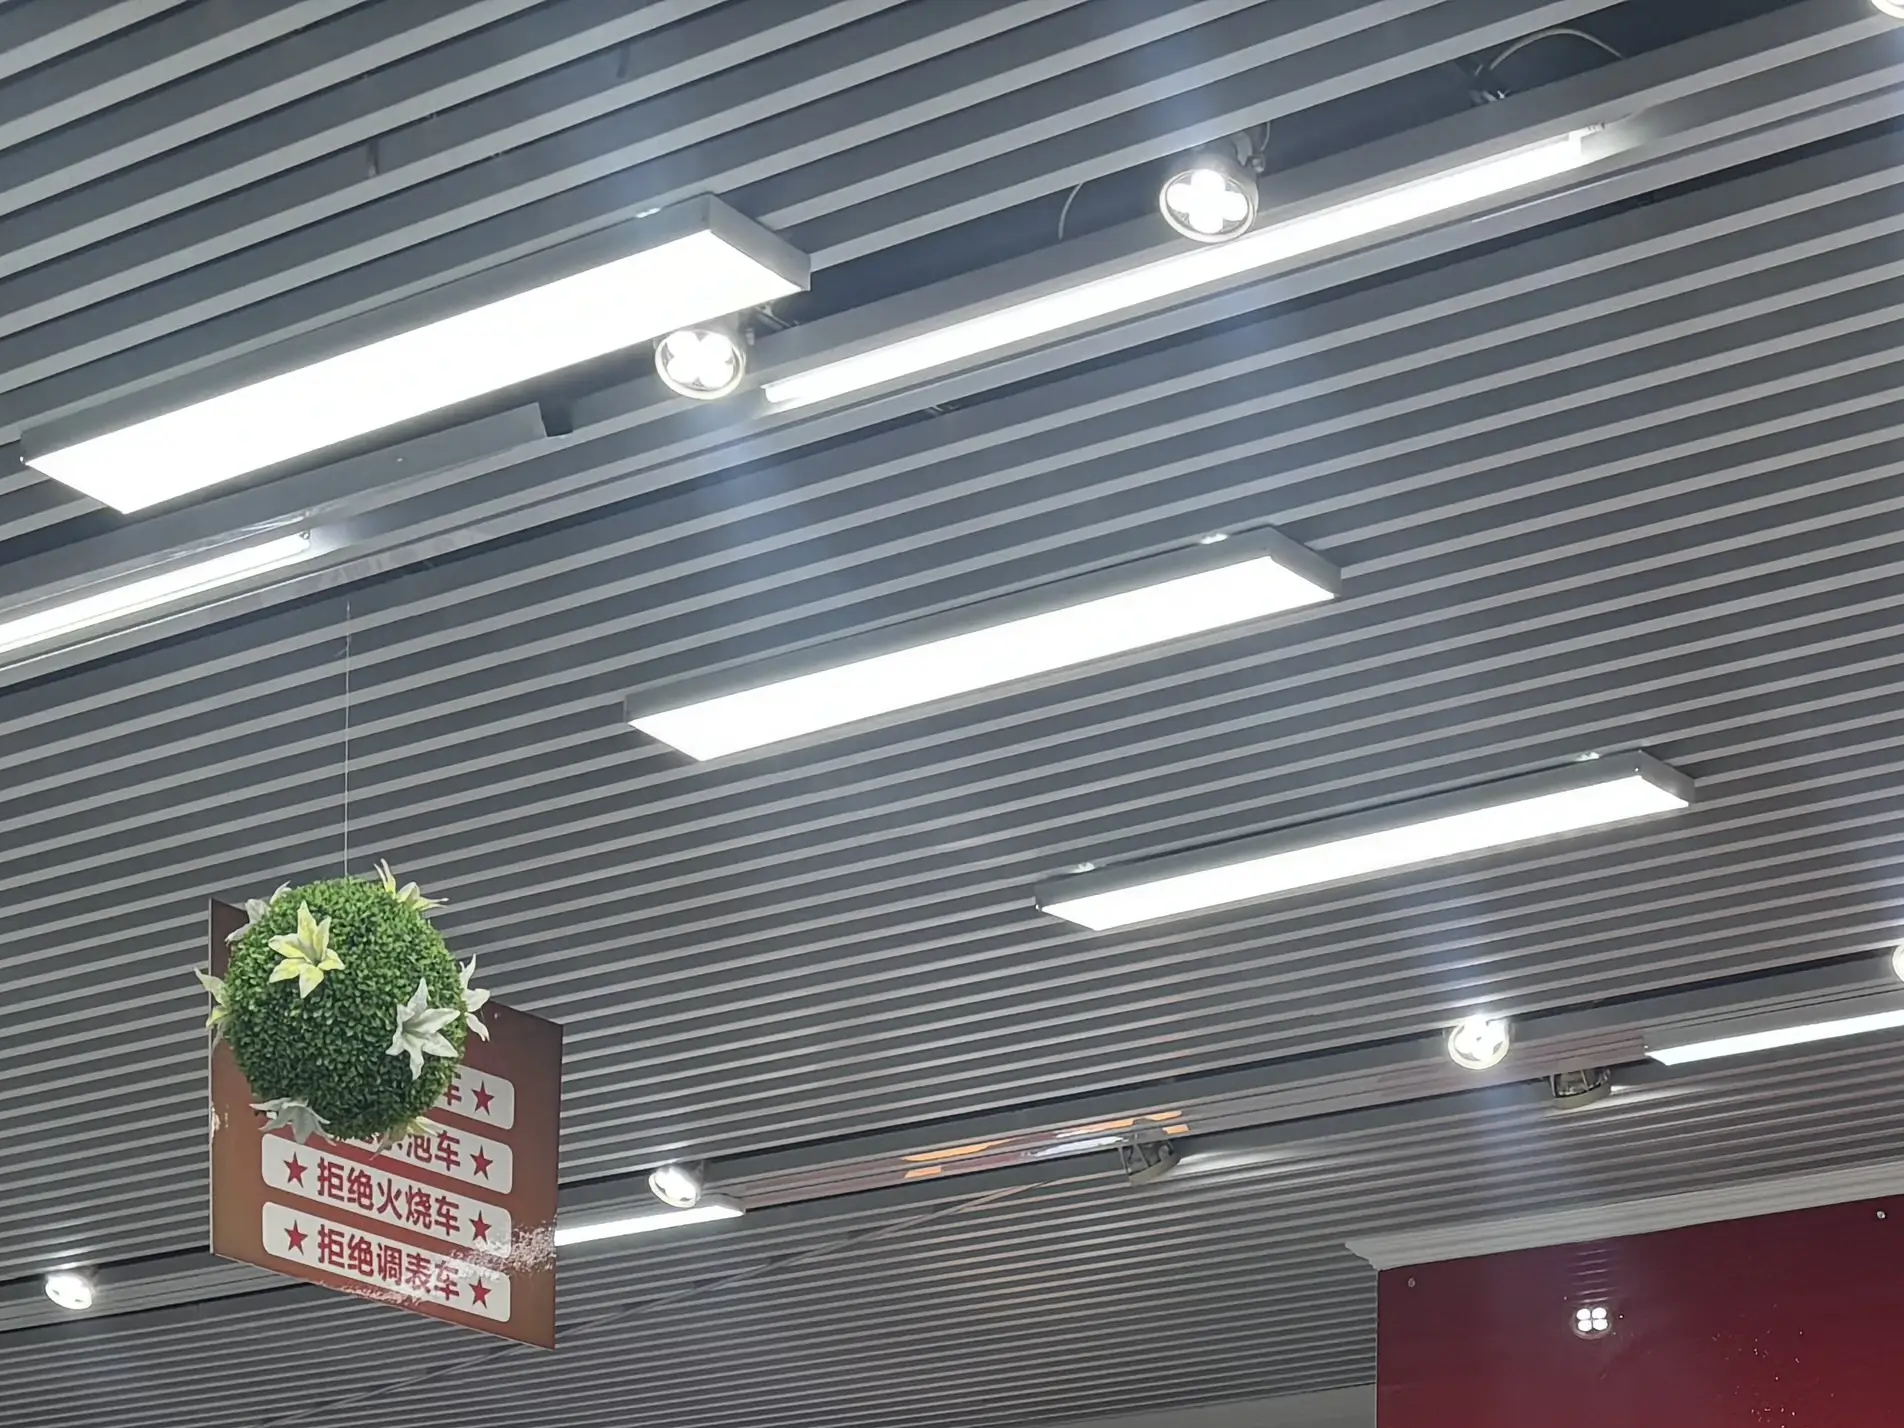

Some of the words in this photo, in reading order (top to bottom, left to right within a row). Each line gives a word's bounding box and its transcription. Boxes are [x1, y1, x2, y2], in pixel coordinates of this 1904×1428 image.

[317, 1157, 461, 1238] 拒绝火烧车
[318, 1223, 461, 1302] 拒绝调表车
